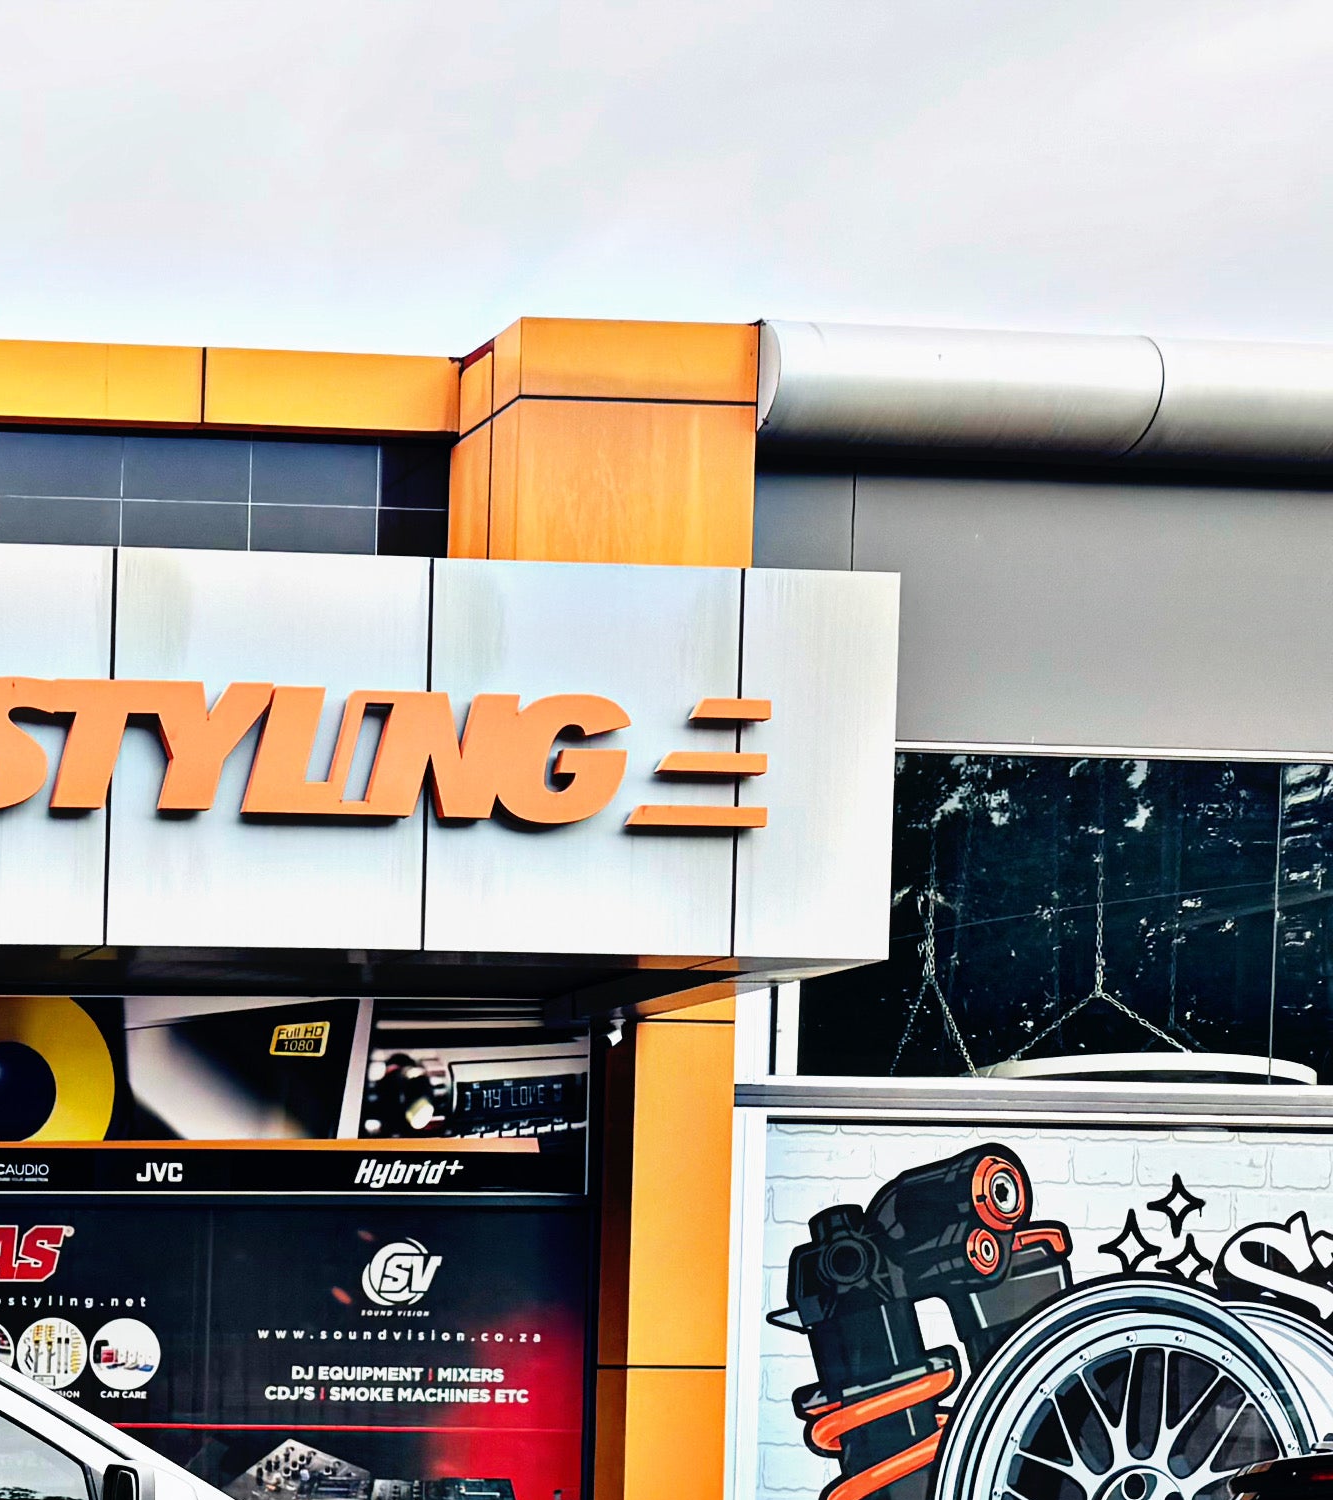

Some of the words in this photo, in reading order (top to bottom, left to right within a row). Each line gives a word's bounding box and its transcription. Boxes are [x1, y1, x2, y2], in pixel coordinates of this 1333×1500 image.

[278, 1027, 301, 1038] Full
[304, 1025, 325, 1038] HD
[283, 1039, 314, 1052] 1080
[136, 1162, 183, 1183] JVC
[354, 1159, 464, 1188] Hybrid+
[380, 1253, 442, 1294] SV
[258, 1329, 542, 1343] www.soundvision.co.za
[291, 1366, 314, 1380] DJ
[318, 1366, 424, 1382] EQUIPMENT
[437, 1368, 505, 1383] MIXERS
[100, 1390, 120, 1399] CAR
[122, 1390, 147, 1399] CARE
[264, 1386, 316, 1401] CDJ'S
[329, 1387, 394, 1402] SMOKE
[398, 1388, 491, 1403] MACHINES
[495, 1389, 529, 1403] ETC
